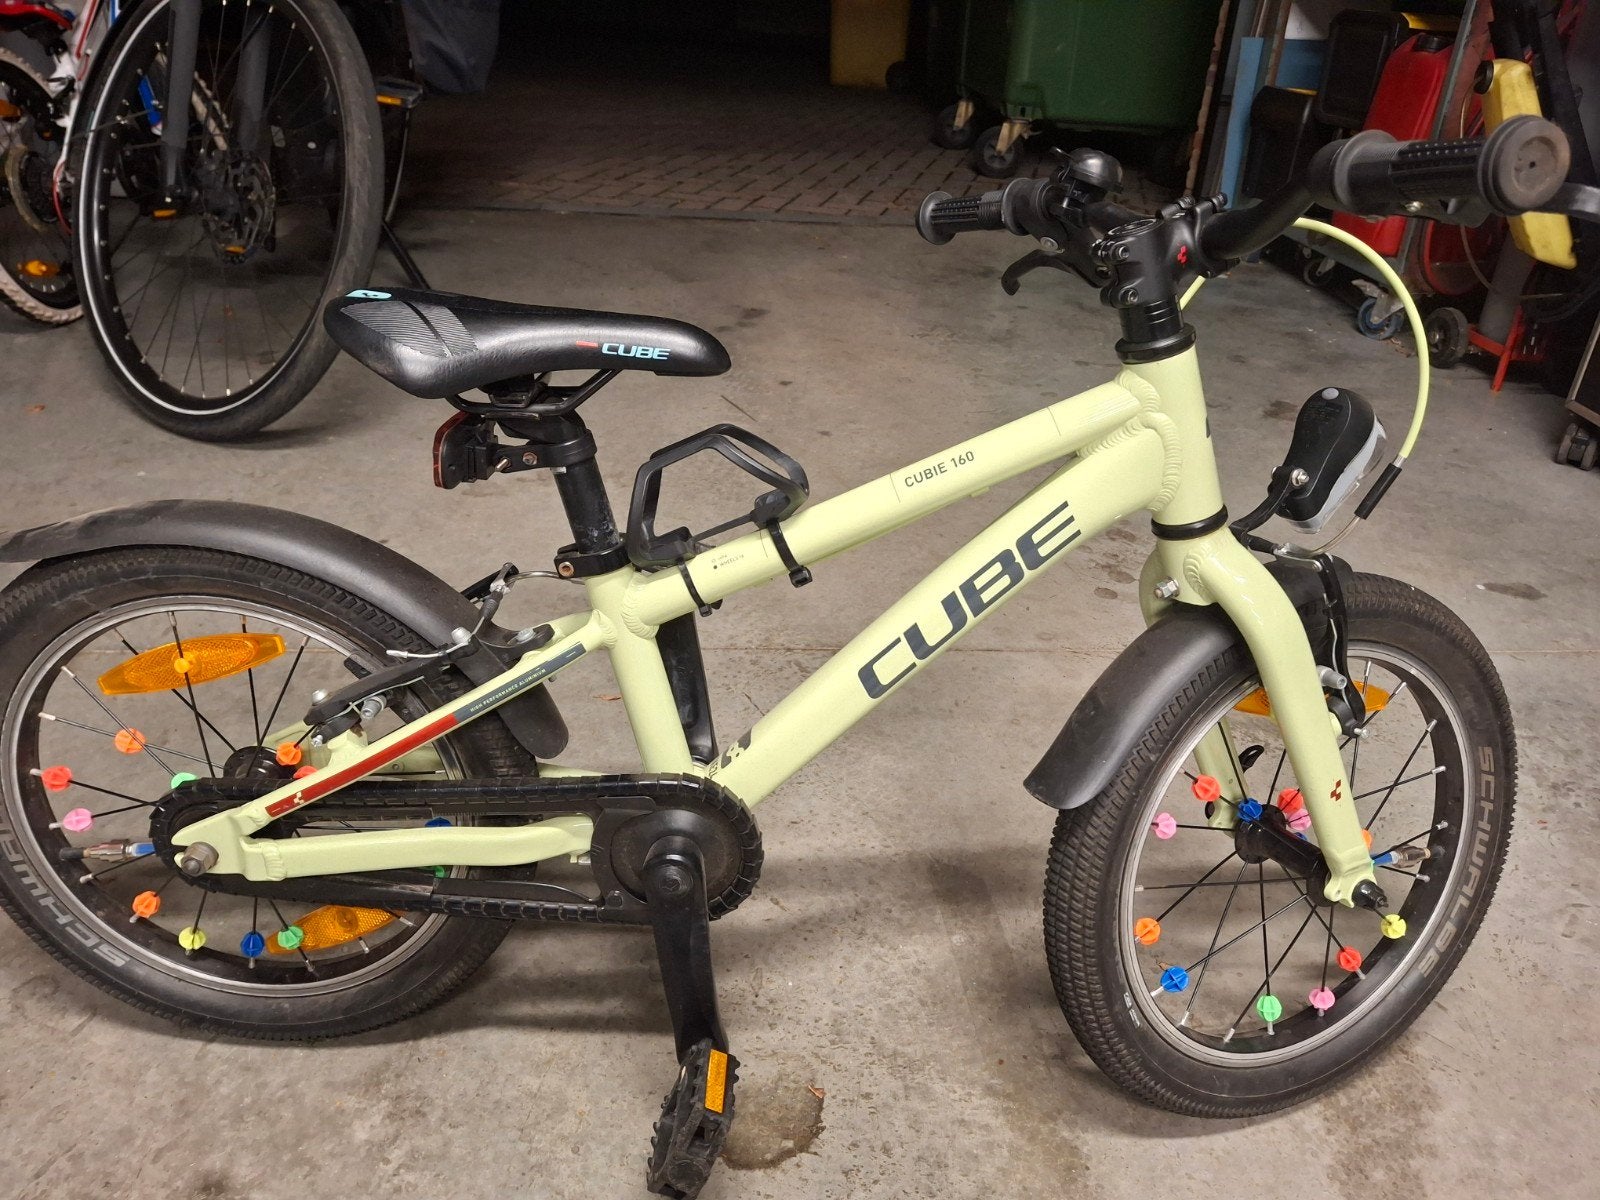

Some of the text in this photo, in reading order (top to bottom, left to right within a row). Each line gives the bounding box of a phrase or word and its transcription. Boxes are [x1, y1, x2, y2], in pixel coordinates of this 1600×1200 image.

[602, 342, 671, 360] CUBE
[904, 451, 974, 487] CUBIE 160
[858, 500, 1081, 699] CUBE
[470, 668, 547, 712] HIGH PERFORMANCE ALUMINIUM
[1417, 745, 1495, 977] SCHWALBE
